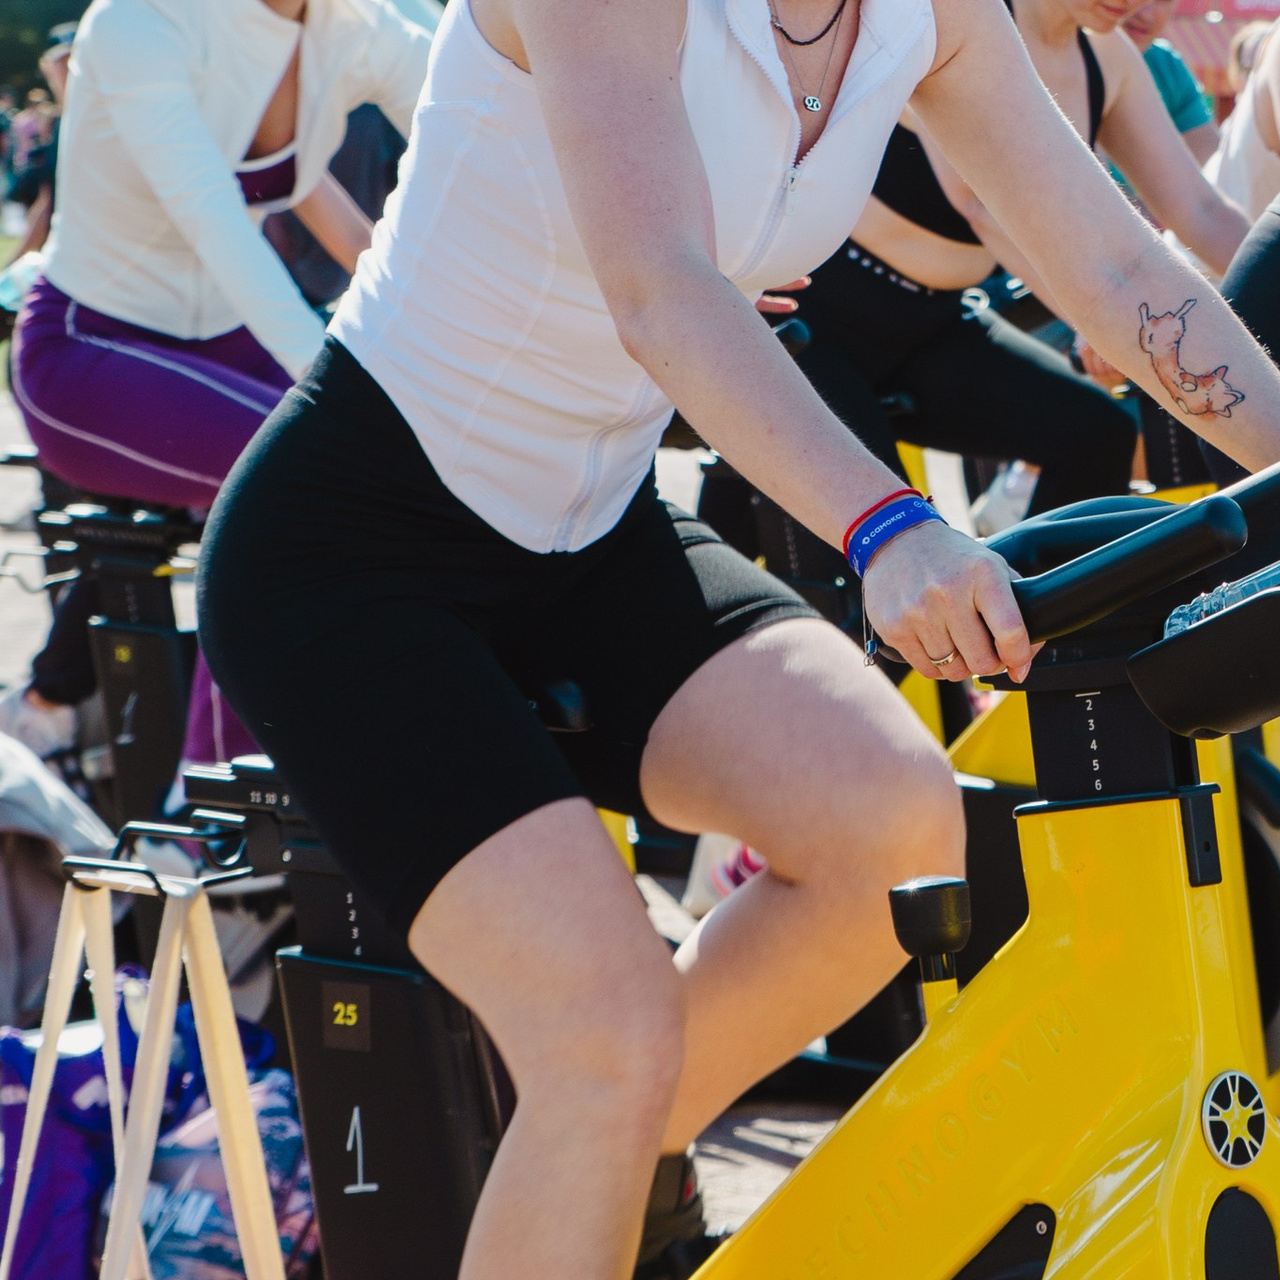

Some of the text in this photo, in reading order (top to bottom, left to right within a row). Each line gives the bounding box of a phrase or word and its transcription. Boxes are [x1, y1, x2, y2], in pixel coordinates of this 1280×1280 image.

[869, 511, 907, 538] самокат
[1085, 699, 1093, 711] 2
[1087, 718, 1095, 731] 3
[1090, 739, 1098, 751] 4
[1092, 759, 1100, 771] 5
[1094, 778, 1102, 791] 6
[332, 1001, 359, 1027] 25
[343, 1105, 380, 1195] 1
